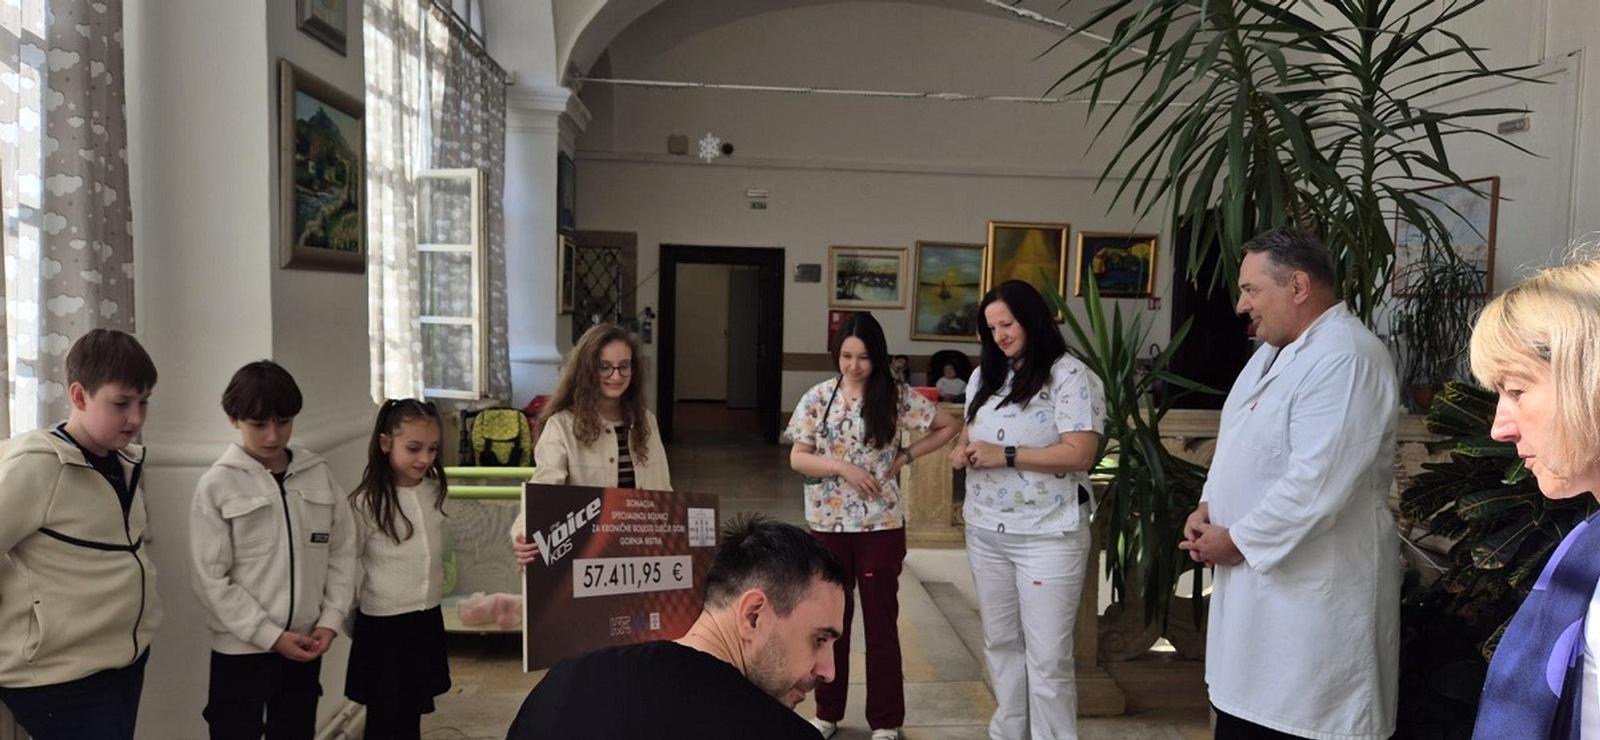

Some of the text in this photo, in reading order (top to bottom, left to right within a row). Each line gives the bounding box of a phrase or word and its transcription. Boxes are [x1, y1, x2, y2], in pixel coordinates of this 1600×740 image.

[532, 497, 601, 567] Voice
[583, 562, 684, 589] 57.411,95 €
